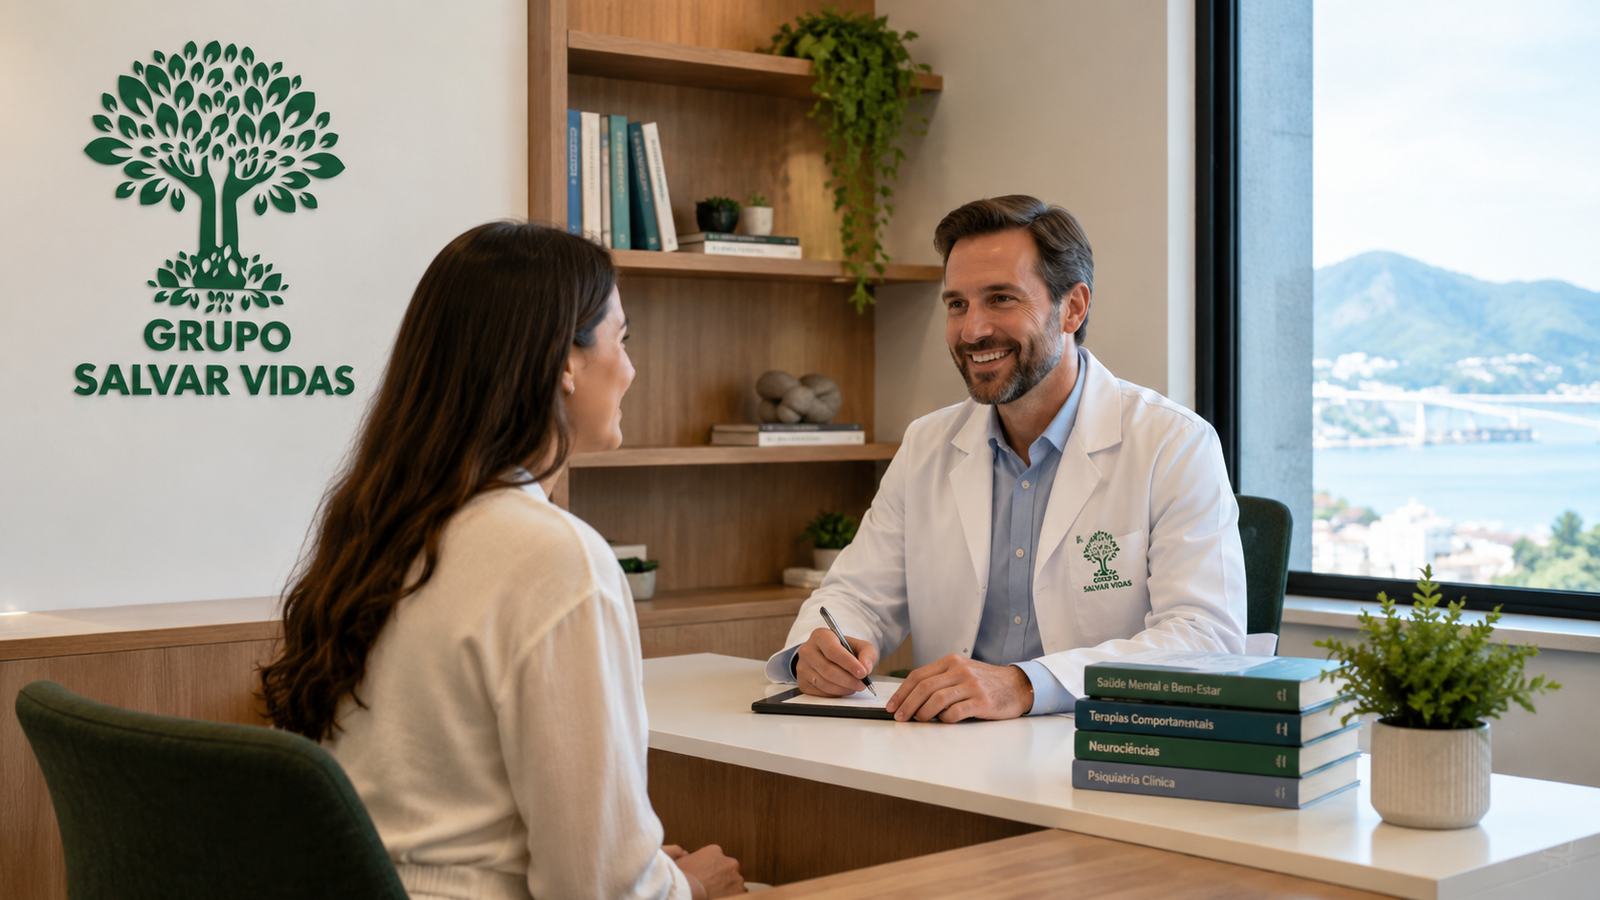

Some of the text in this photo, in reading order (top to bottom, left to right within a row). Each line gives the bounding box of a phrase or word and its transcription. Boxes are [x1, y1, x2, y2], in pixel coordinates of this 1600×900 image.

[143, 318, 292, 352] GRUPO
[74, 363, 356, 396] SALVAR VIDAS
[1128, 679, 1161, 691] Mental
[1163, 683, 1169, 692] e
[1171, 682, 1222, 695] Bem-Estar
[1089, 710, 1129, 725] Terapias
[1088, 770, 1140, 785] Psiquiatria
